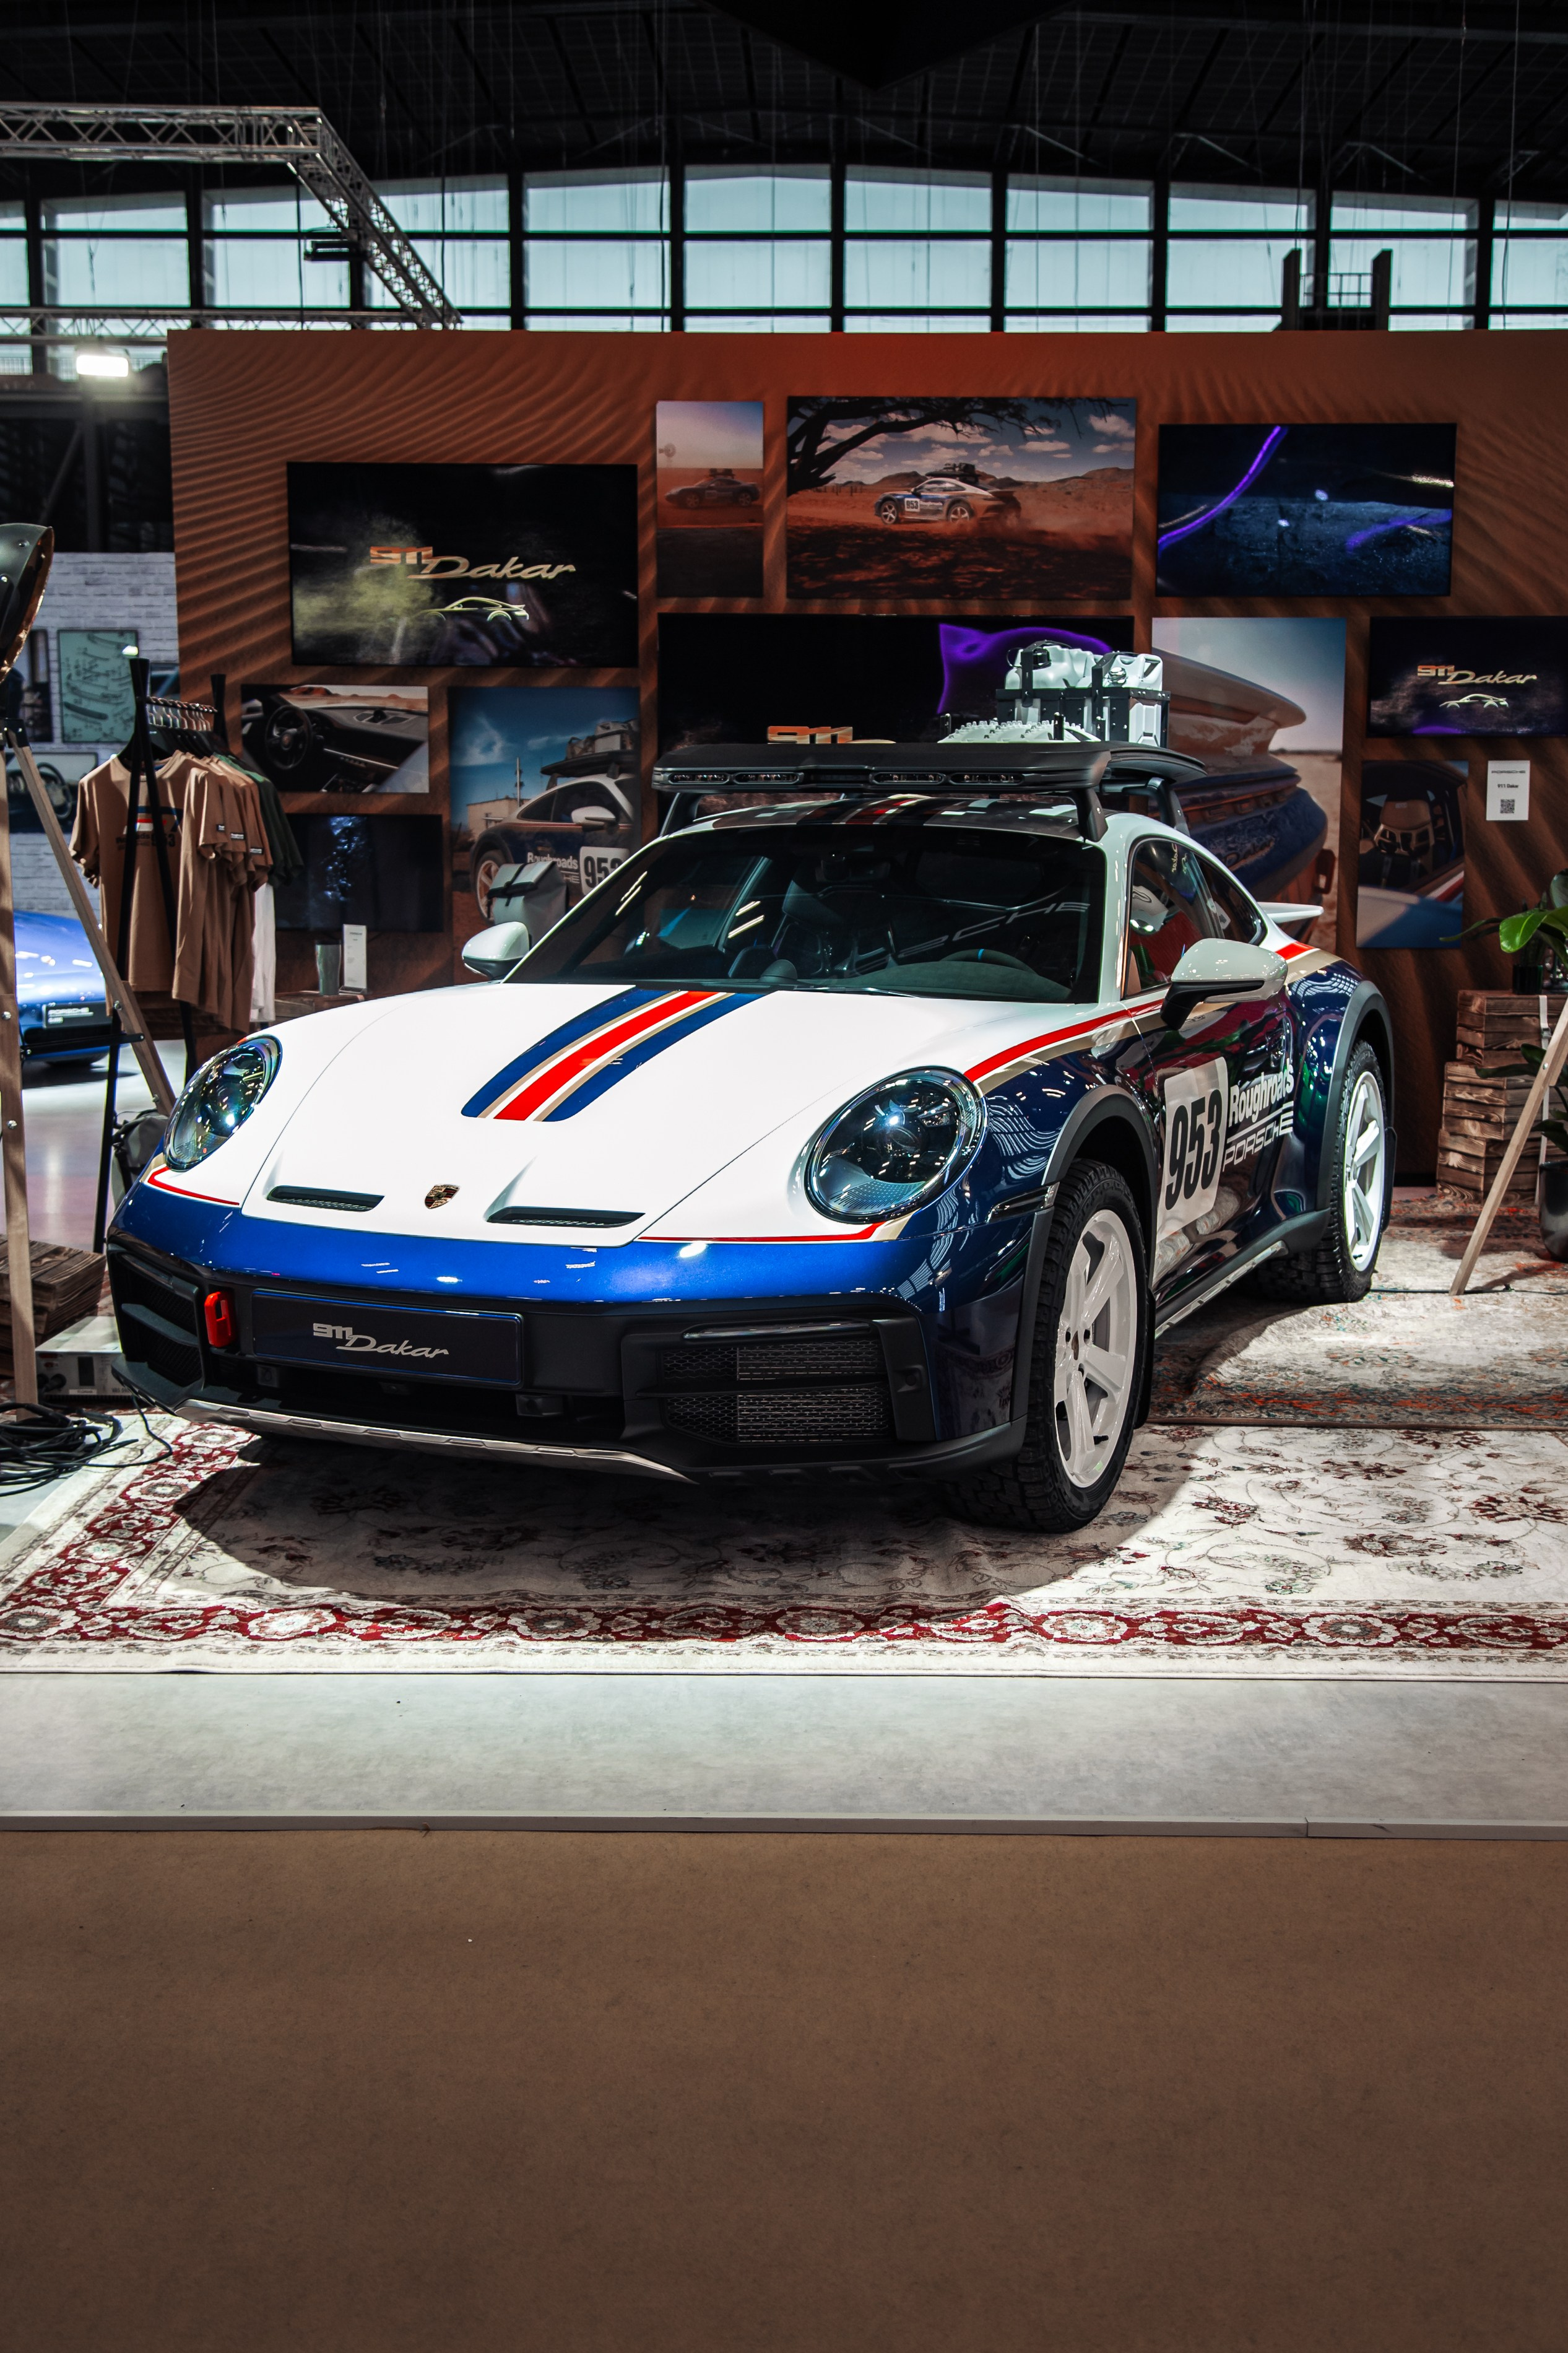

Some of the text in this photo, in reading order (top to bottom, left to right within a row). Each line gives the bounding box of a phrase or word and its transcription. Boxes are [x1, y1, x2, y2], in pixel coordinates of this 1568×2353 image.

[370, 546, 576, 578] 911 Dakar
[1418, 665, 1538, 685] 911 Dakar
[767, 726, 853, 744] 911
[1165, 1058, 1294, 1211] 953 Roughroads
[1222, 1111, 1294, 1172] PORSCHE
[313, 1323, 449, 1358] 911 Dakar
